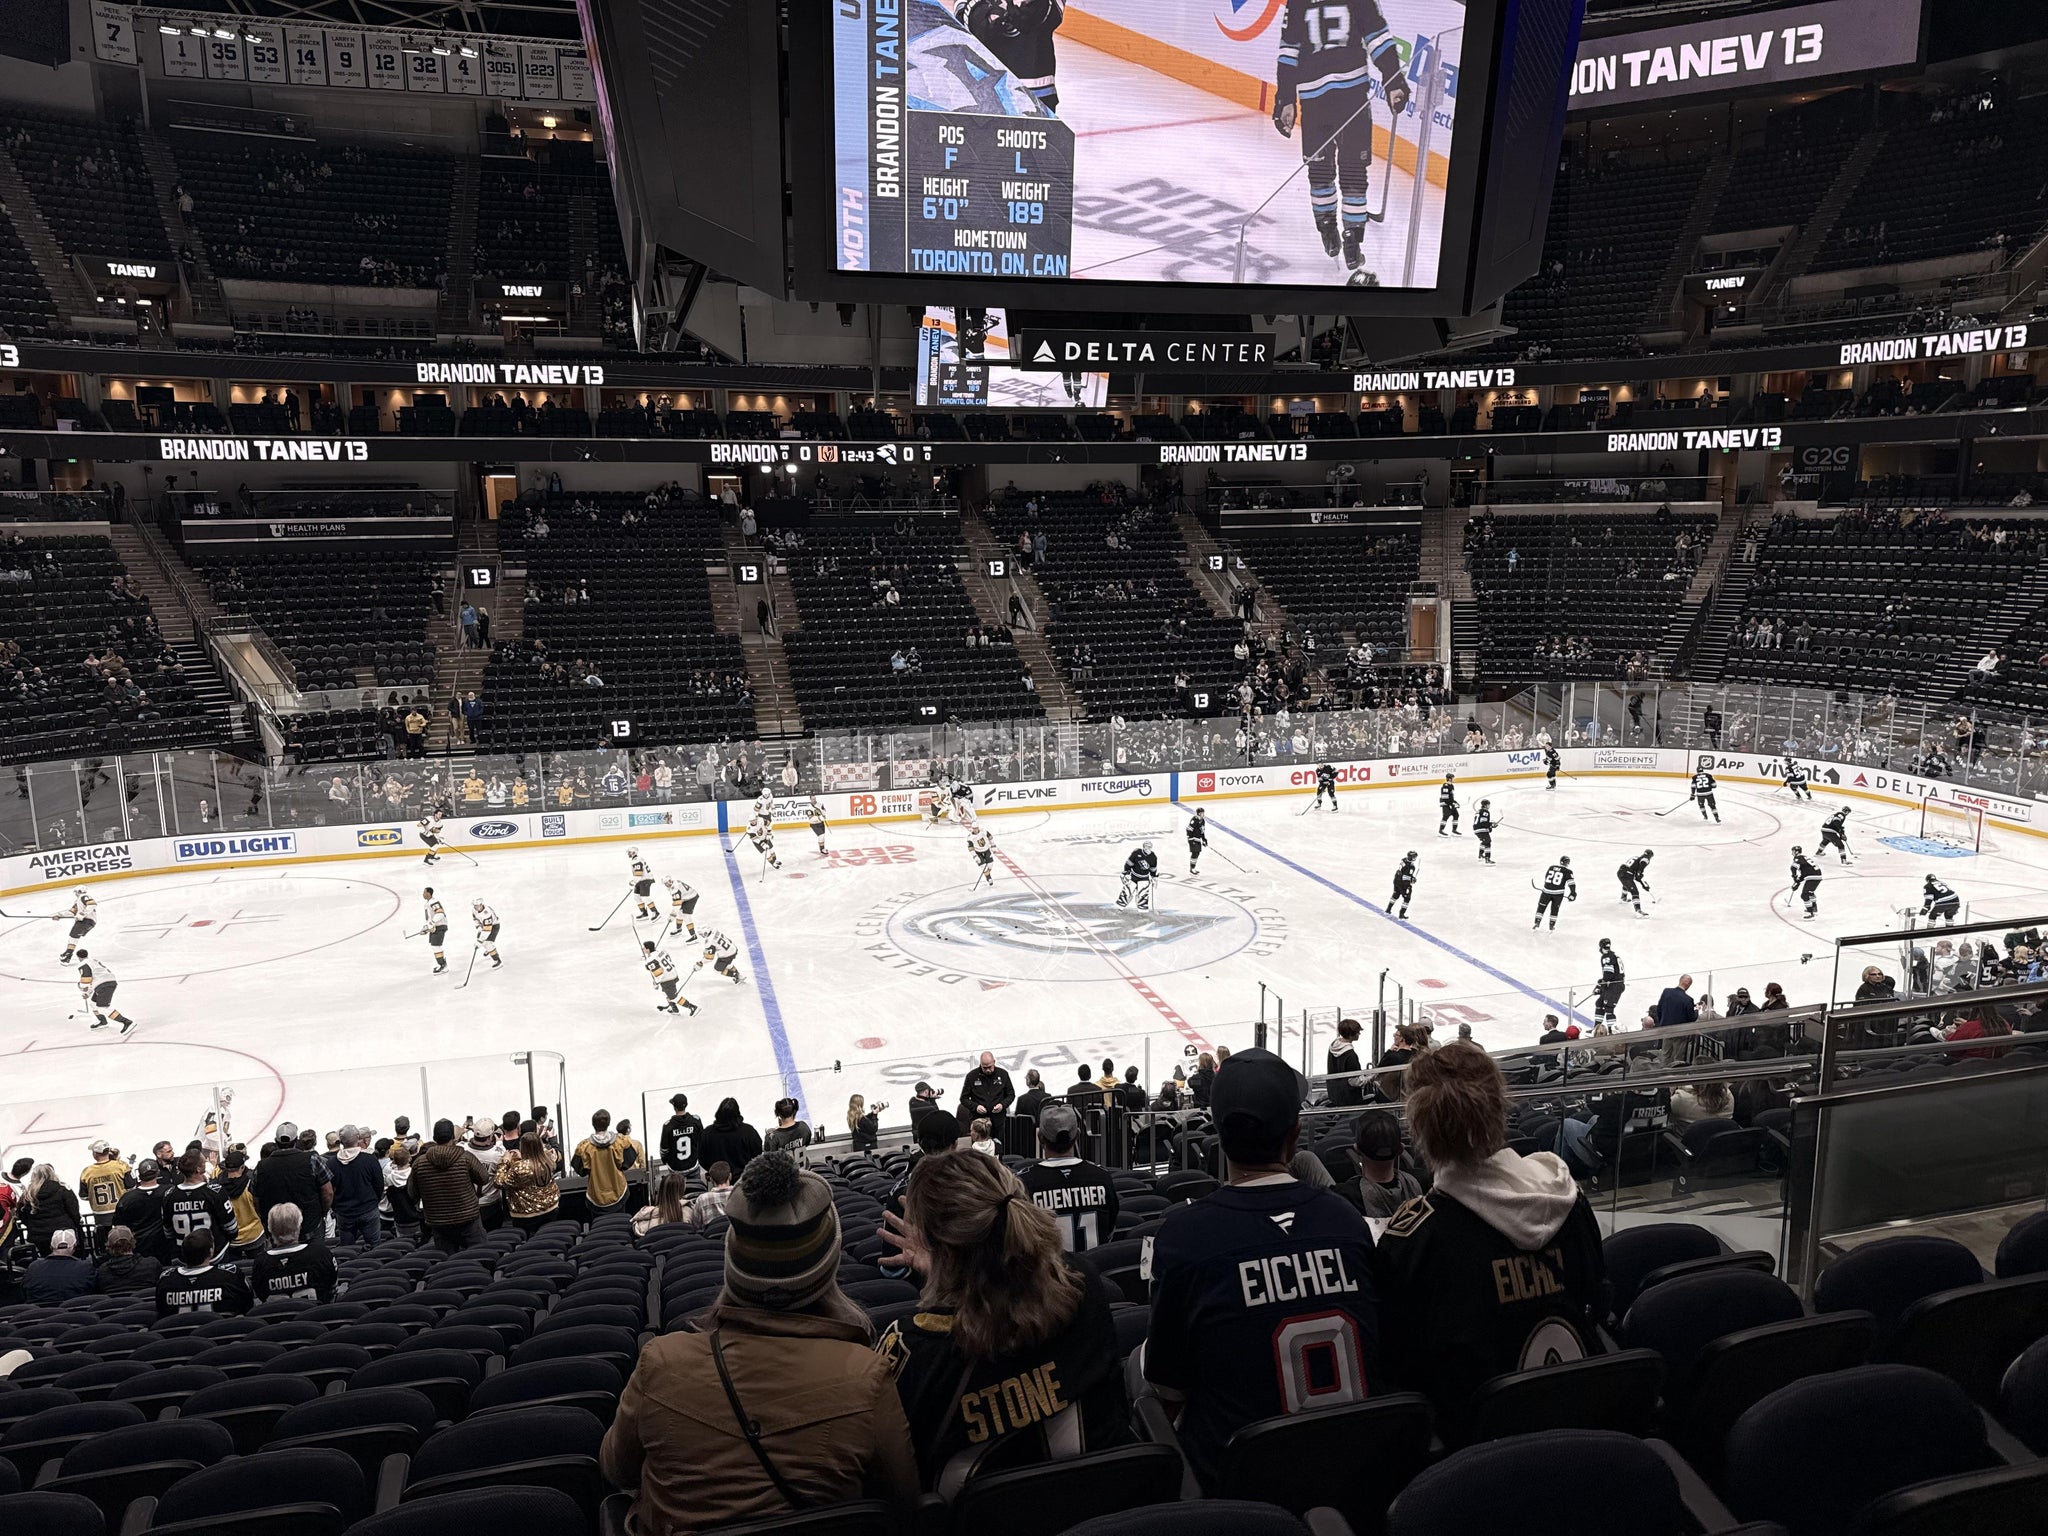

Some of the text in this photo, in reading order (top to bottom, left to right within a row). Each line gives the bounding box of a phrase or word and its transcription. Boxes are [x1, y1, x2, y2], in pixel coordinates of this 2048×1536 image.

[106, 23, 121, 42] 7
[1304, 5, 1350, 54] 13
[178, 41, 187, 57] 1
[212, 43, 237, 60] 35
[253, 46, 279, 64] 53
[296, 49, 317, 67] 14
[1622, 30, 1774, 87] TANEV
[1780, 23, 1824, 65] 13
[340, 52, 352, 69] 9
[375, 54, 396, 71] 12
[413, 57, 437, 74] 32
[458, 59, 469, 76] 4
[487, 61, 517, 75] 3051
[525, 63, 555, 77] 1223
[876, 87, 900, 198] BRANDON
[938, 126, 965, 145] POS
[997, 129, 1047, 150] SHOOTS
[945, 147, 959, 170] F
[1015, 151, 1027, 174] L
[923, 177, 970, 197] HEIGHT
[1002, 181, 1050, 201] WEIGHT
[1007, 201, 1044, 225] 189
[842, 187, 864, 271] MOTH
[954, 229, 1027, 249] HOMETOWN
[107, 263, 157, 279] TANEV
[911, 249, 1067, 277] TORONTO, ON, CAN
[502, 285, 543, 297] TANEV
[1706, 277, 1745, 290] TANEV
[932, 318, 941, 327] 13
[1065, 342, 1266, 362] DELTA CENTER
[1840, 325, 2028, 365] BRANDON TANEV 13
[930, 329, 940, 386] BRANDON TANEV
[417, 363, 604, 384] BRANDON TANEV 13
[1353, 368, 1515, 392] BRANDON TANEV 13
[1607, 427, 1782, 452] BRANDON TANEV 13
[160, 439, 368, 461] BRANDON TANEV 13
[711, 444, 778, 463] BRANDON
[781, 451, 789, 460] 0
[800, 446, 811, 461] 0
[841, 450, 874, 462] 12:43
[903, 447, 914, 461] 0
[924, 452, 931, 461] 0
[1160, 444, 1307, 463] BRANDON TANEV 13
[1802, 447, 1849, 466] G2G
[287, 523, 346, 532] HEALTH PLANS
[989, 561, 1004, 576] 13
[1209, 556, 1223, 570] 13
[471, 568, 491, 585] 13
[740, 565, 757, 581] 13
[1194, 694, 1209, 708] 13
[611, 721, 630, 737] 13
[1402, 764, 1428, 772] HEALTH
[1598, 756, 1653, 764] INGREDIENTS
[1290, 764, 1370, 786] enata
[1758, 759, 1820, 782] vivnt
[1219, 775, 1264, 786] TOYOTA
[1695, 778, 1709, 788] 22
[1876, 776, 1939, 798] DELTA
[997, 787, 1057, 801] FILEVINE
[850, 795, 878, 816] PB
[881, 794, 913, 804] PEANUT
[882, 804, 913, 814] BETTER
[1993, 803, 2026, 815] STEEL
[543, 816, 562, 826] BUILT
[600, 816, 620, 825] G2G
[638, 813, 656, 823] G2G
[682, 812, 700, 820] G2G
[362, 832, 399, 843] IKEA
[478, 822, 509, 837] Ford
[544, 828, 563, 836] TOUGH
[178, 836, 291, 858] BUD LIGHT
[29, 844, 130, 869] AMERICAN
[44, 857, 133, 880] EXPRESS
[1545, 870, 1563, 885] 28
[1157, 872, 1289, 960] DELTA CENTER
[855, 889, 959, 986] DELTA CENTER
[676, 1136, 692, 1160] 9
[94, 1184, 117, 1206] 61
[1033, 1185, 1106, 1211] GUENTHER
[173, 1201, 205, 1212] COOLEY
[172, 1212, 213, 1246] 92
[268, 1273, 308, 1291] COOLEY
[1238, 1248, 1359, 1308] EICHEL
[166, 1288, 222, 1306] GUENTHER
[960, 1361, 1069, 1444] STONE
